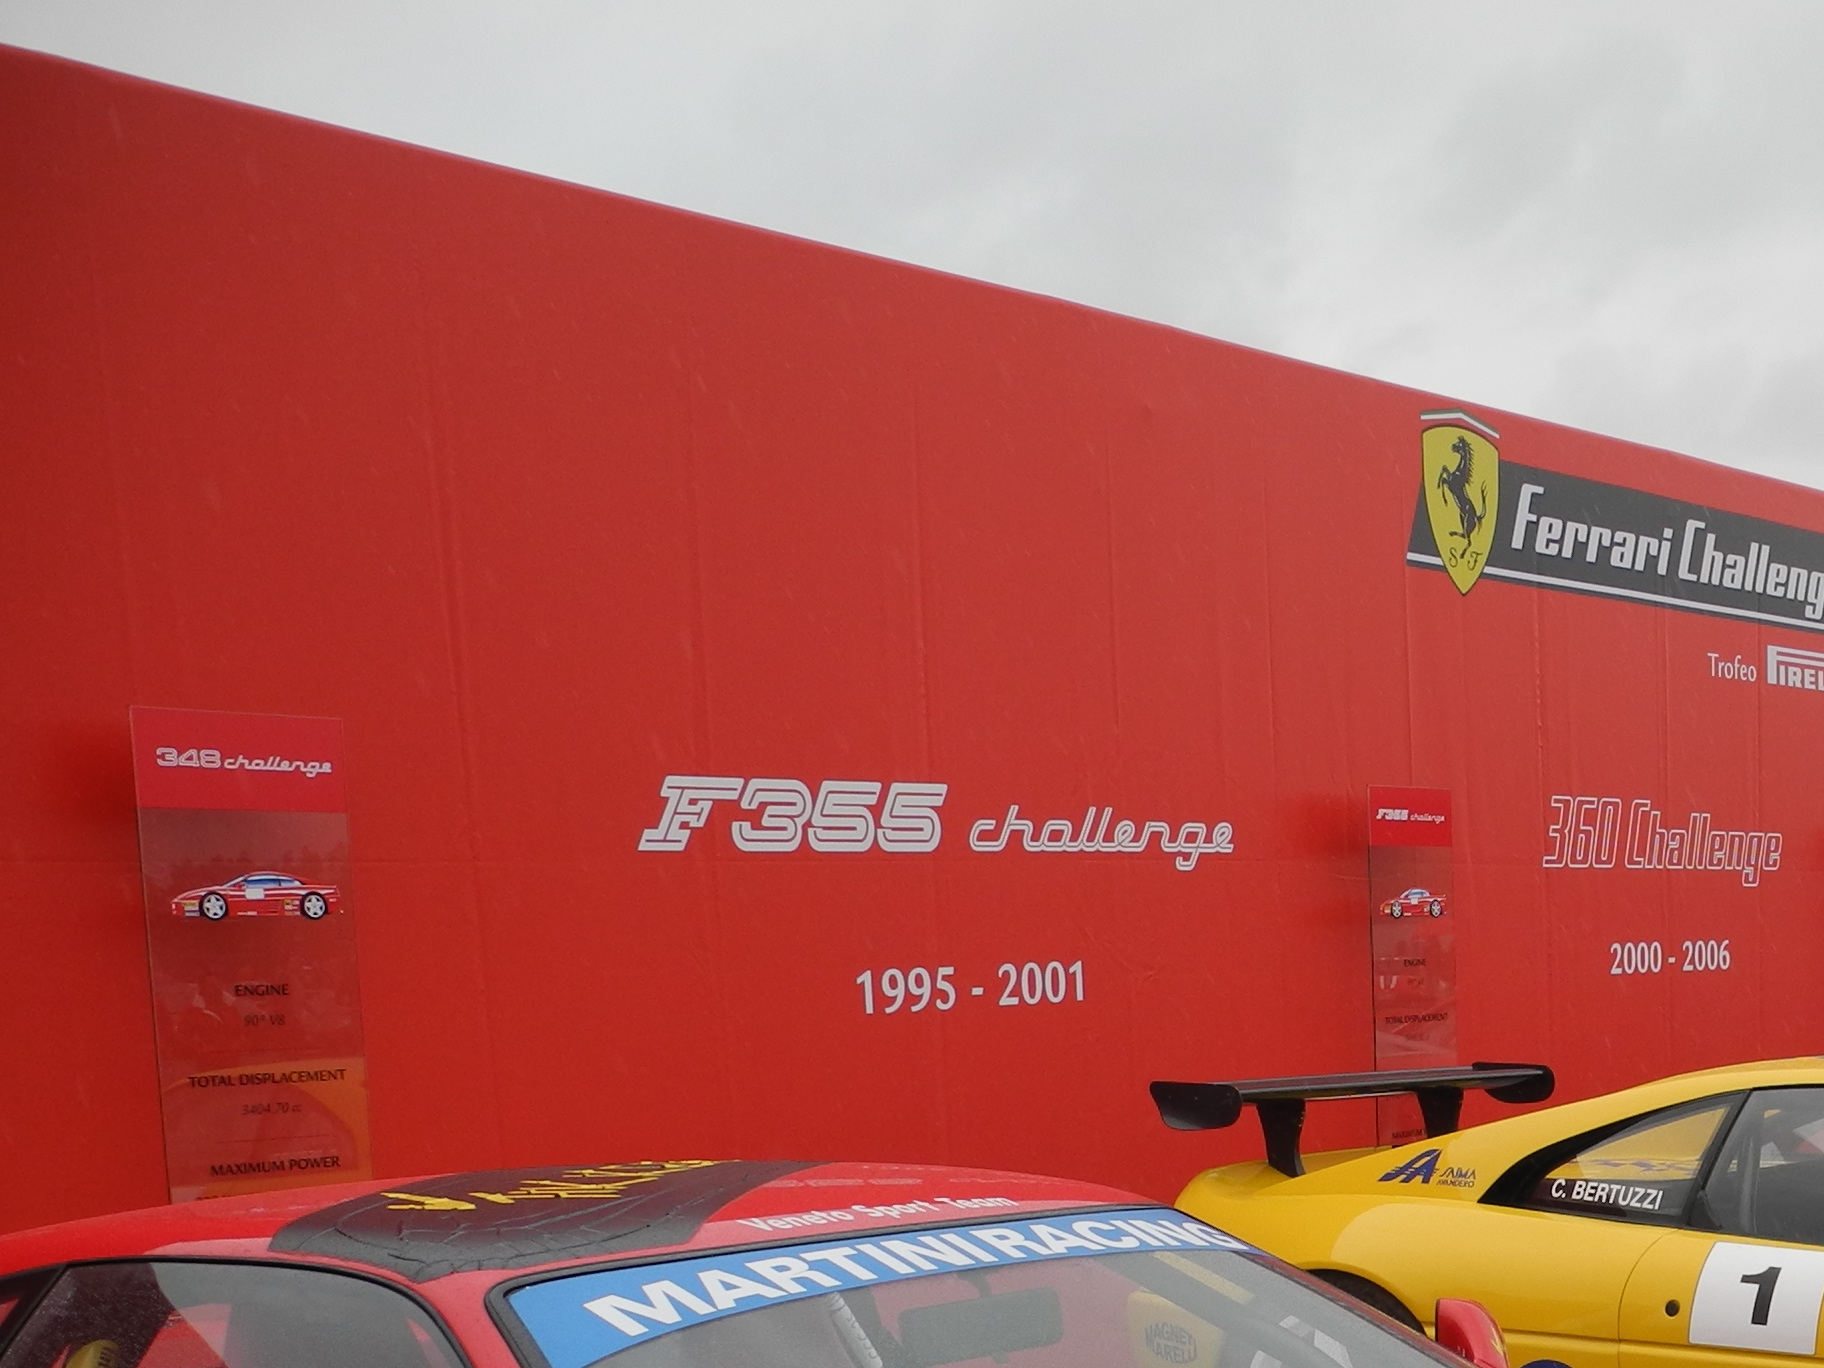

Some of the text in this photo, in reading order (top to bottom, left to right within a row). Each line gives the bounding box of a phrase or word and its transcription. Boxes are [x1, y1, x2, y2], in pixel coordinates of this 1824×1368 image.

[1510, 483, 1675, 577] Ferrari
[1707, 653, 1758, 682] Trofeo
[156, 747, 333, 778] 348 challenge
[637, 774, 1235, 871] F355 challenge
[1542, 795, 1784, 888] 360 Challenge
[1609, 942, 1663, 976] 2000
[1682, 939, 1731, 971] 2006
[234, 983, 290, 997] ENGINE
[856, 960, 1087, 1014] 1995 - 2001
[188, 1068, 347, 1089] TOTAL DISPLACEMENT
[210, 1155, 342, 1177] MAXIMUM POWER
[1551, 1179, 1663, 1211] C. BERTUZZI
[737, 1196, 1020, 1233] Veneto Sport Team
[583, 1217, 1250, 1337] MARTINI RACING
[1739, 1266, 1782, 1327] 1
